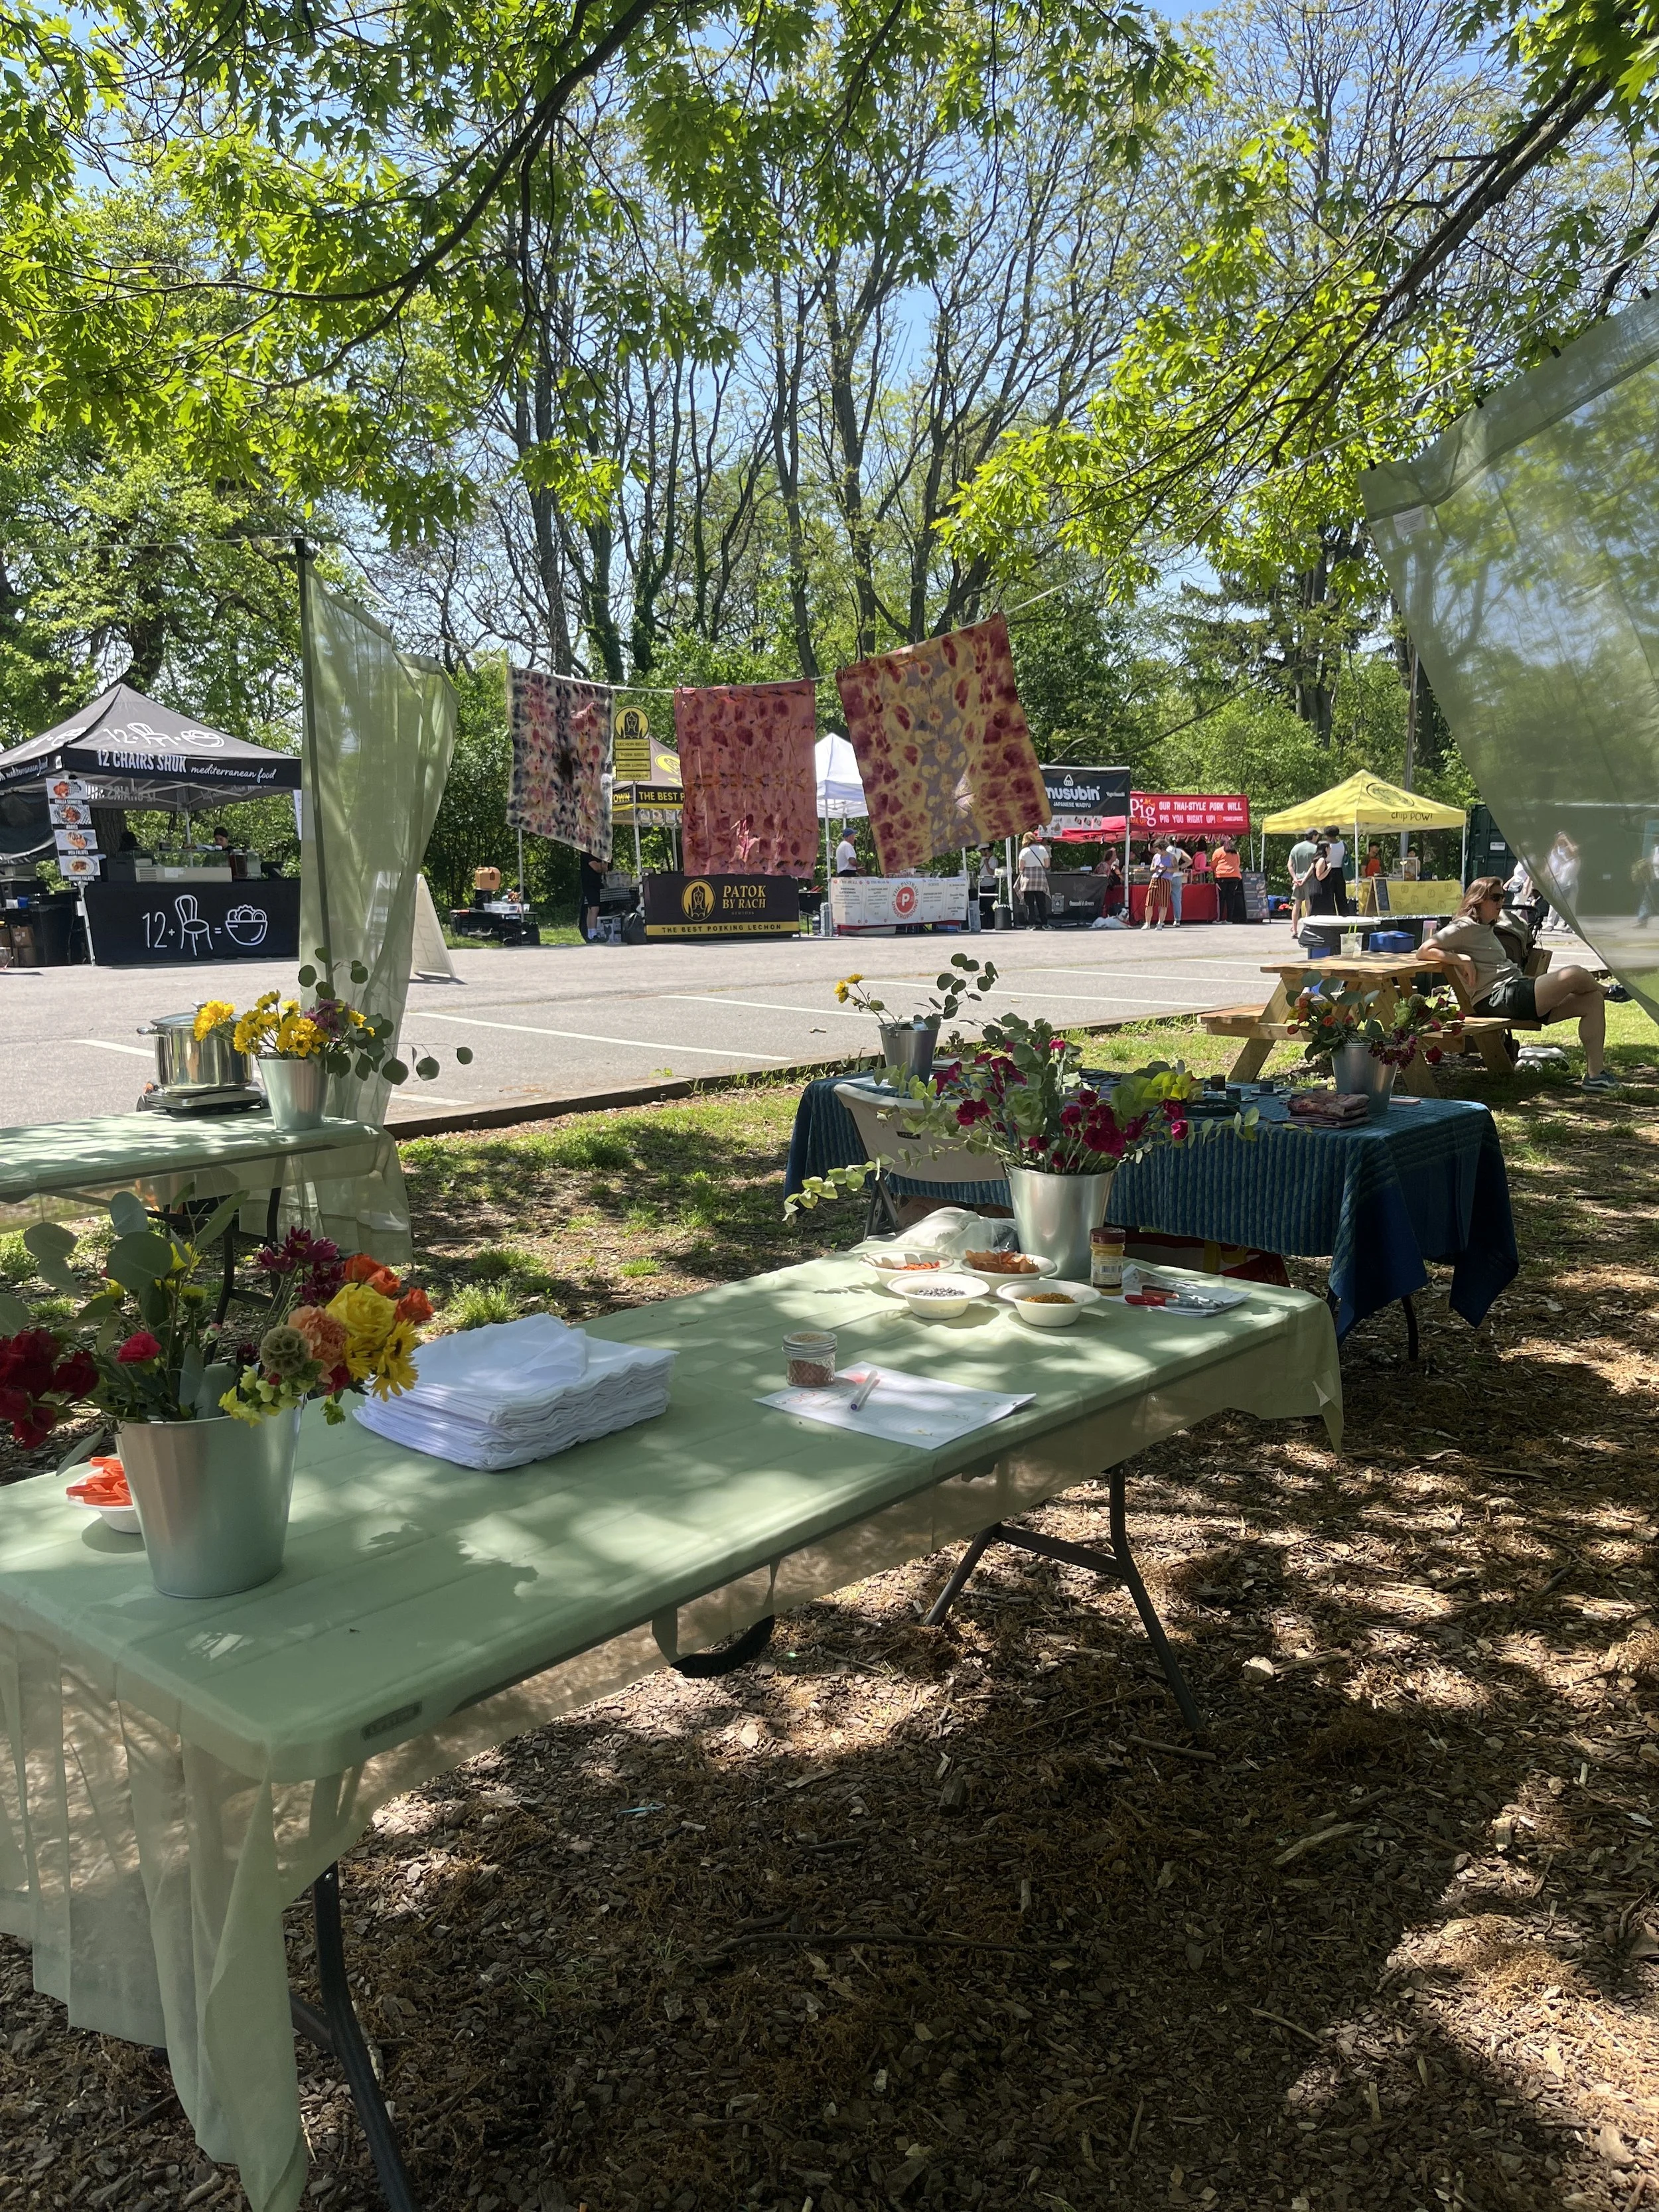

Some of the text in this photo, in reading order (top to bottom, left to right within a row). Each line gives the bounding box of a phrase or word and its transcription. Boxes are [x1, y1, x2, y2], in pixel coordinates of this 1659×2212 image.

[96, 749, 187, 773] 12 CHAIRS SHUK
[190, 763, 277, 784] mediterranean food
[638, 792, 655, 801] THE
[657, 792, 678, 801] BEST
[1129, 798, 1157, 827] Pig
[1159, 802, 1242, 812] OUR THAI-STYLE PORK WILL
[1159, 814, 1216, 824] PIG YOU RIGHT UP!
[1410, 812, 1433, 822] POW!
[723, 885, 766, 898] PATOK
[722, 898, 766, 909] BY RACH
[891, 899, 919, 920] UNDERGROUND
[142, 911, 167, 948] 12
